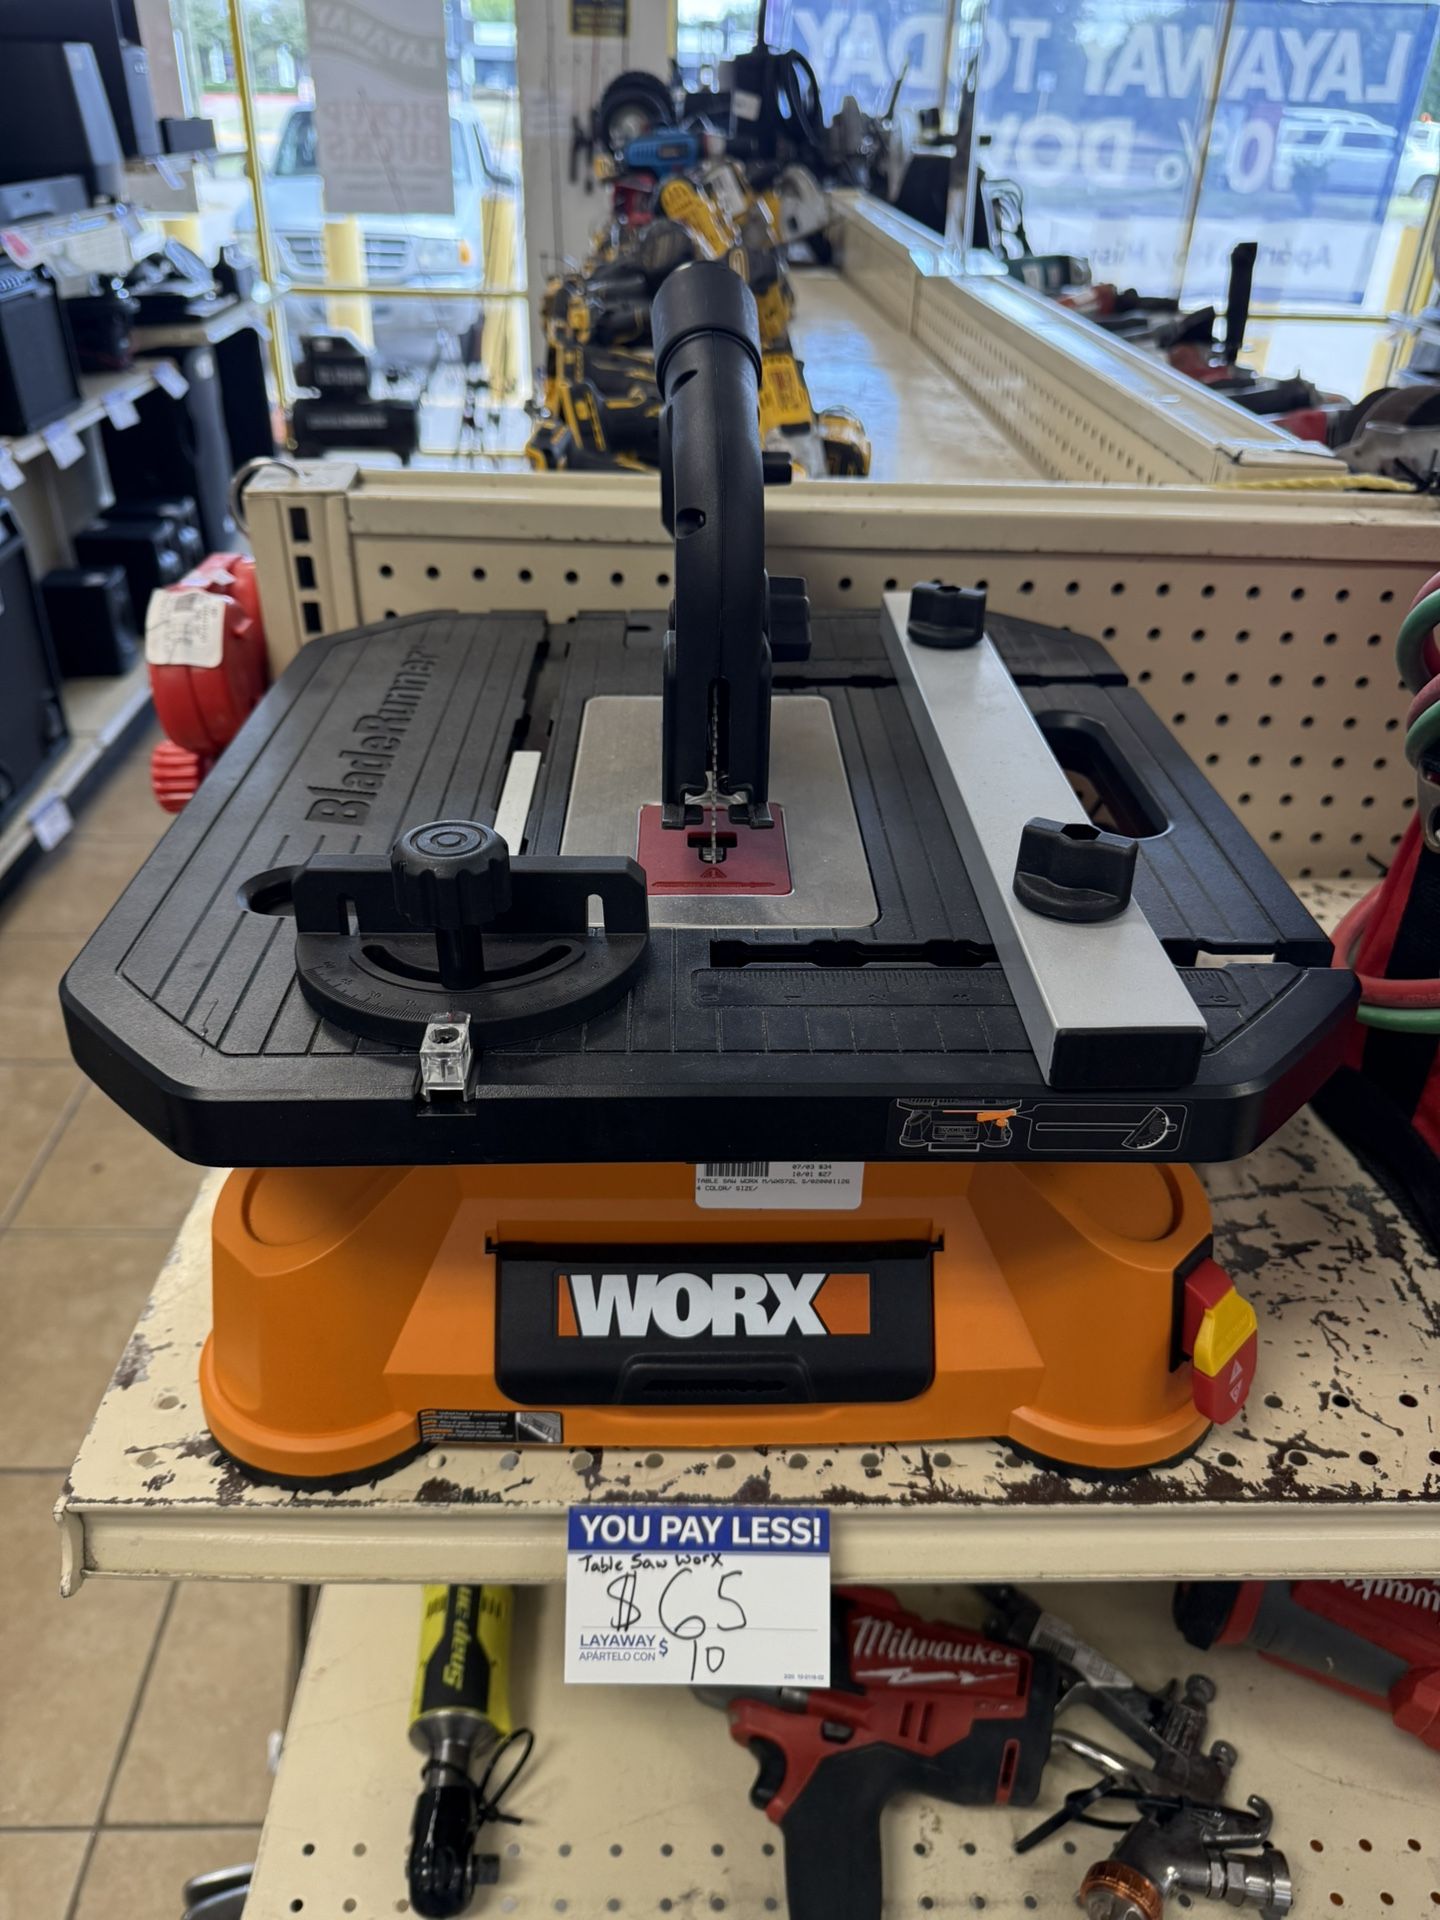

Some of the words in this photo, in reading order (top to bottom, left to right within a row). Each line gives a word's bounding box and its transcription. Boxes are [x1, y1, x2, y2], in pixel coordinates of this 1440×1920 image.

[304, 651, 440, 826] BladeRunner
[570, 1272, 828, 1338] WORX
[580, 1514, 650, 1544] YOU
[660, 1515, 724, 1545] PAY
[732, 1516, 821, 1546] LESS!
[578, 1554, 624, 1573] Table
[631, 1553, 668, 1570] Saw
[579, 1649, 631, 1662] APÁRTELO
[633, 1651, 656, 1661] CON
[580, 1634, 656, 1648] LAYAWAY
[851, 1615, 1018, 1668] Milwaukee
